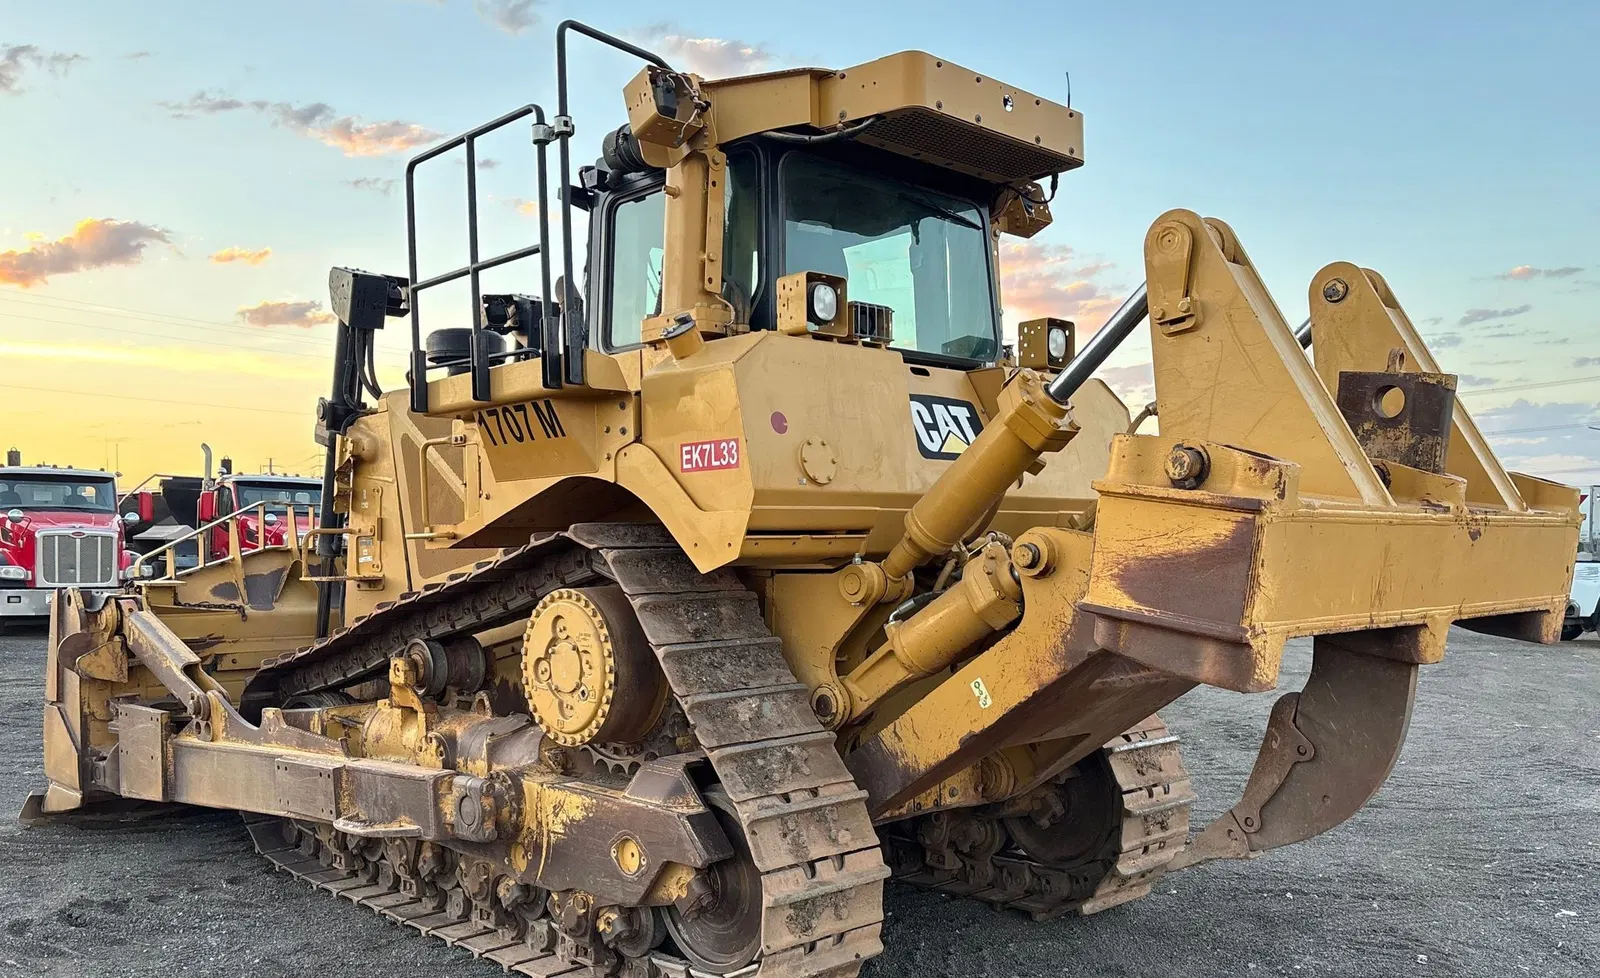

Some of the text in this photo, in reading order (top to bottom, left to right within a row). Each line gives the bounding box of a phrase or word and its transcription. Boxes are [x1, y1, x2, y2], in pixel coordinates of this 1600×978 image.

[477, 398, 567, 447] 1707 M
[909, 400, 976, 452] CAT
[682, 440, 738, 470] EK7L33
